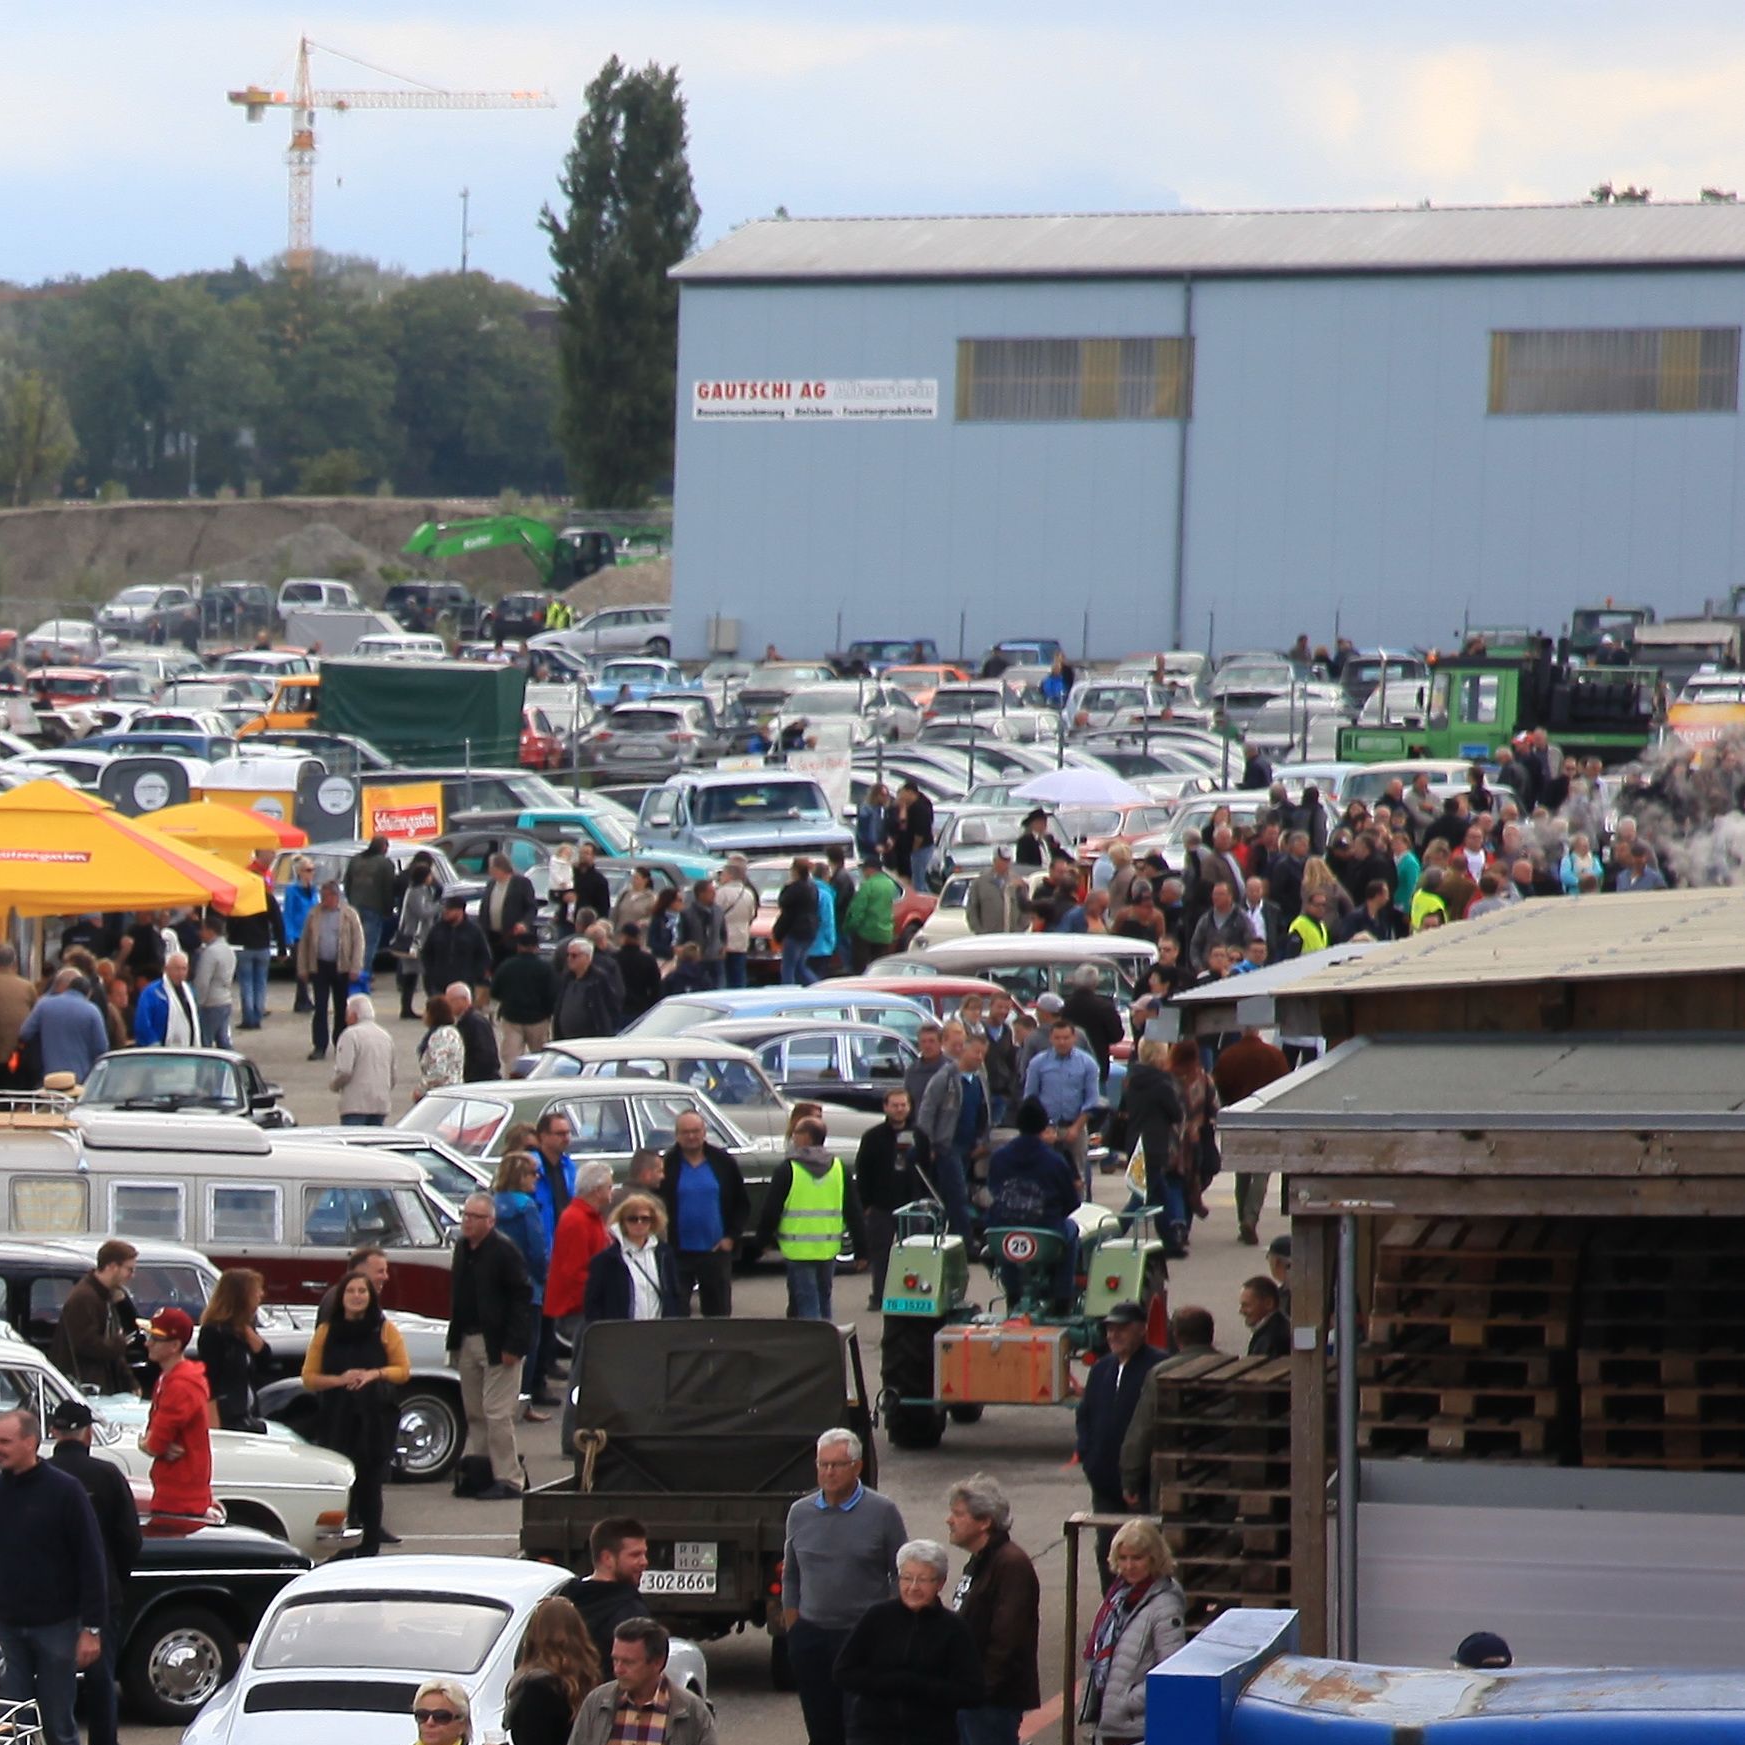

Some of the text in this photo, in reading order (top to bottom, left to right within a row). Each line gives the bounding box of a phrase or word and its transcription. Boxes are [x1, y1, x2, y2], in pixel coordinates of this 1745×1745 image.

[696, 381, 792, 400] GAUTSCHI
[799, 381, 827, 400] AG
[1013, 1240, 1028, 1253] 25
